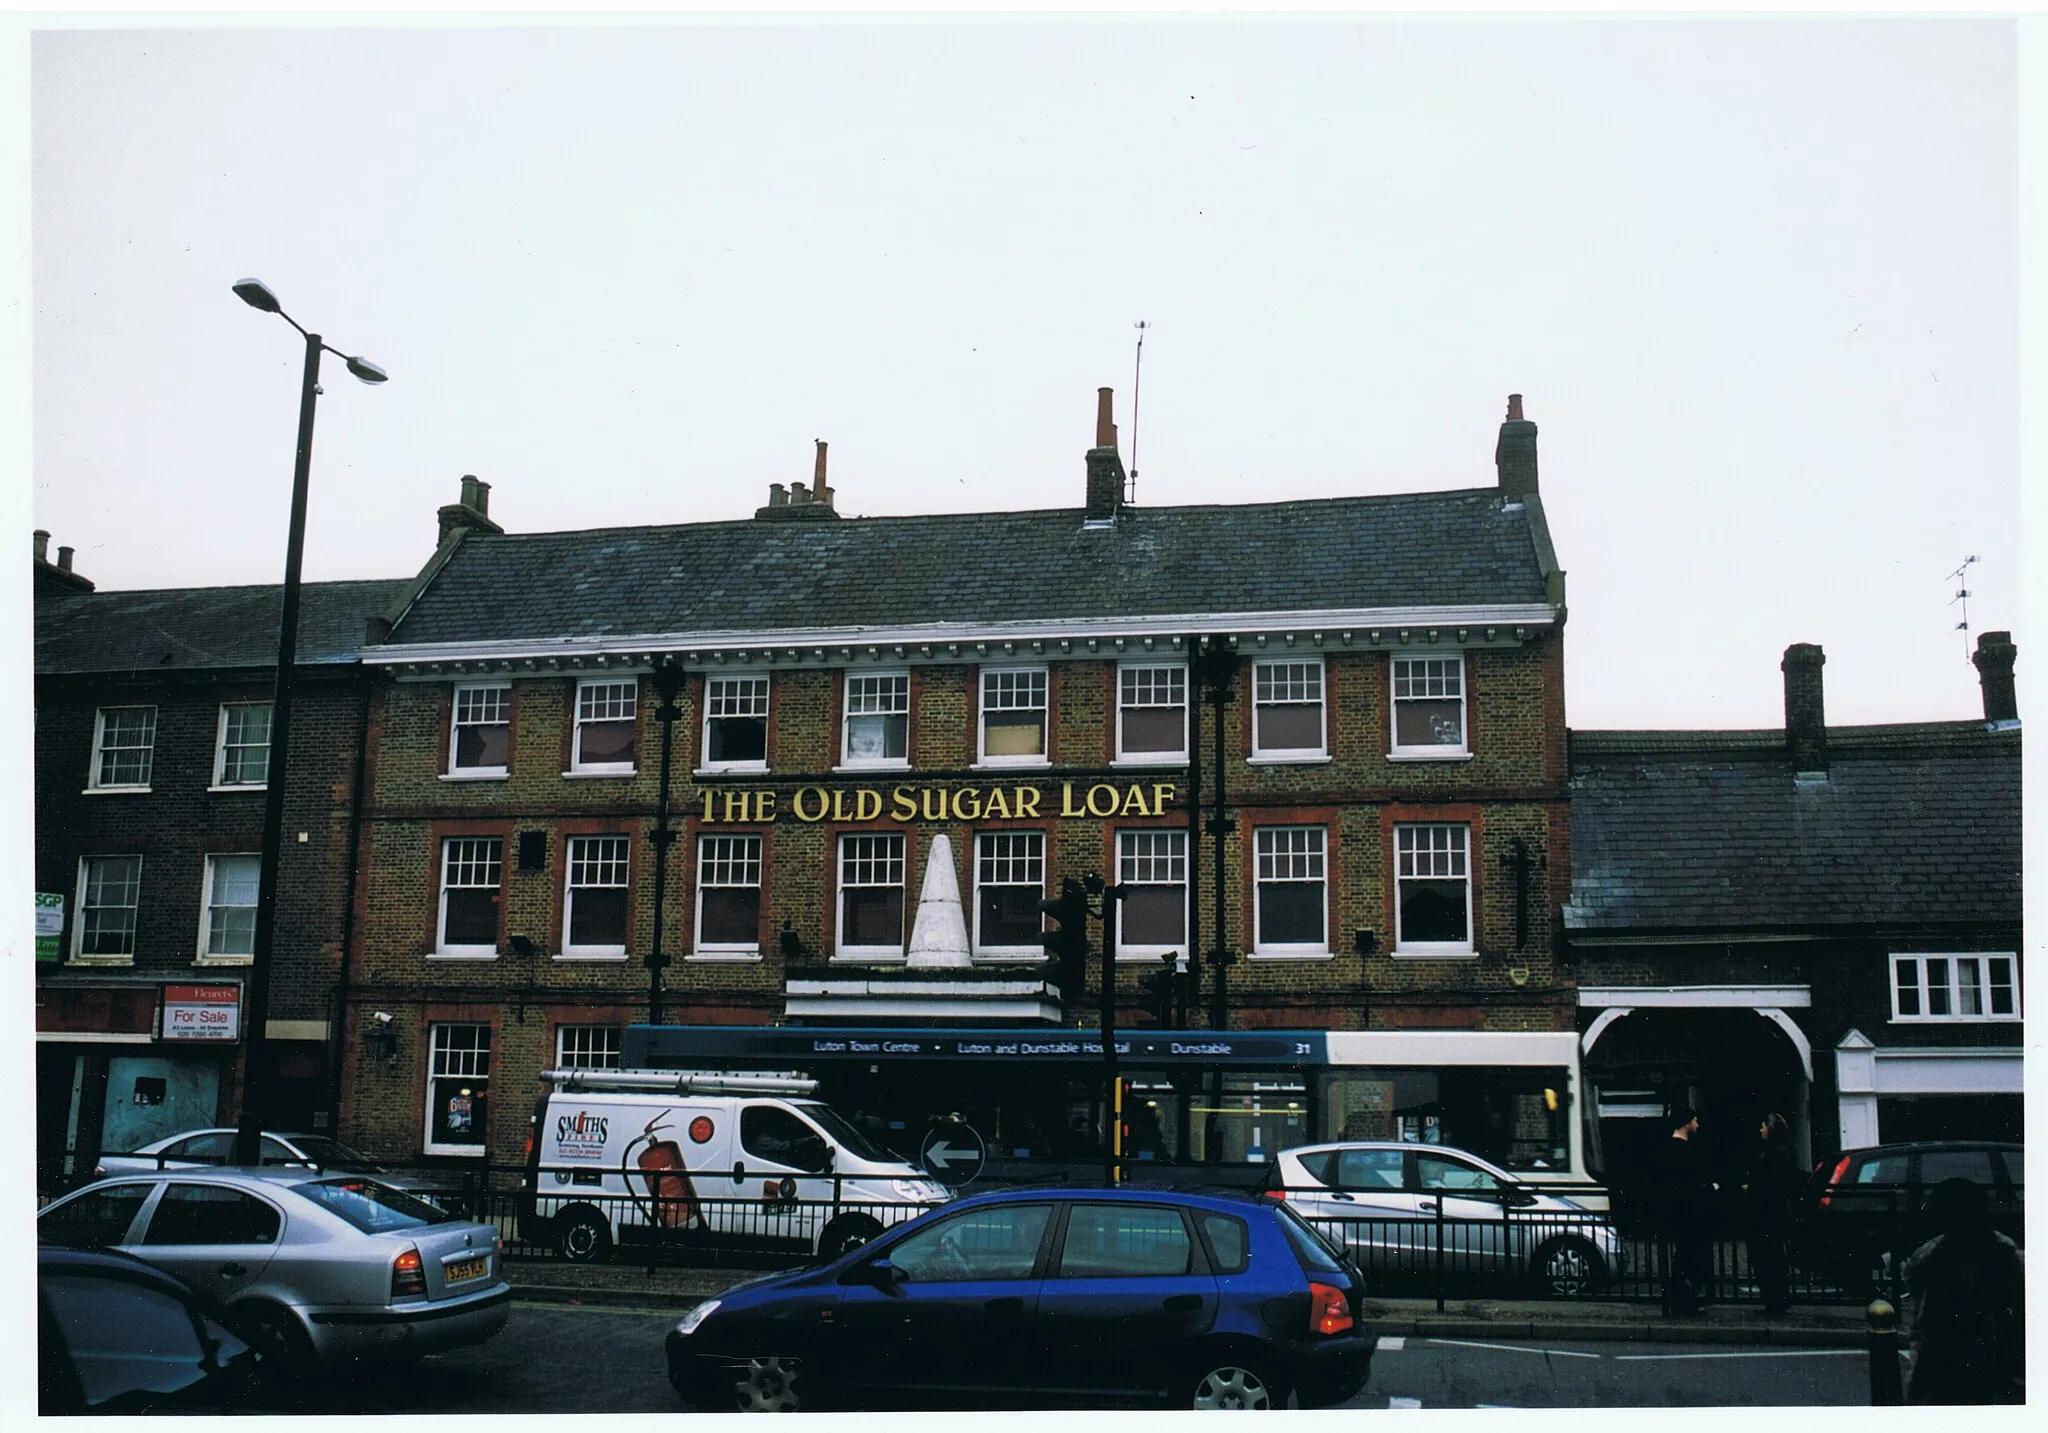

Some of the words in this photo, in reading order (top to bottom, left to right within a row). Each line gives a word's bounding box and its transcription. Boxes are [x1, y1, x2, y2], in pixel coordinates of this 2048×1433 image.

[698, 786, 777, 823] THE
[792, 785, 883, 823] OLD
[890, 784, 1042, 822] SUGAR
[1059, 780, 1176, 818] LOAF
[174, 1009, 196, 1023] For
[200, 1010, 228, 1023] Sale
[814, 1041, 846, 1051] Luton
[849, 1041, 879, 1052] Town
[882, 1041, 920, 1052] Centre
[958, 1043, 991, 1053] Luton
[995, 1043, 1017, 1054] and
[1021, 1043, 1079, 1054] Dunstable
[1171, 1043, 1232, 1054] Dunstable
[1296, 1043, 1310, 1054] 31
[556, 1111, 608, 1145] SMITHS
